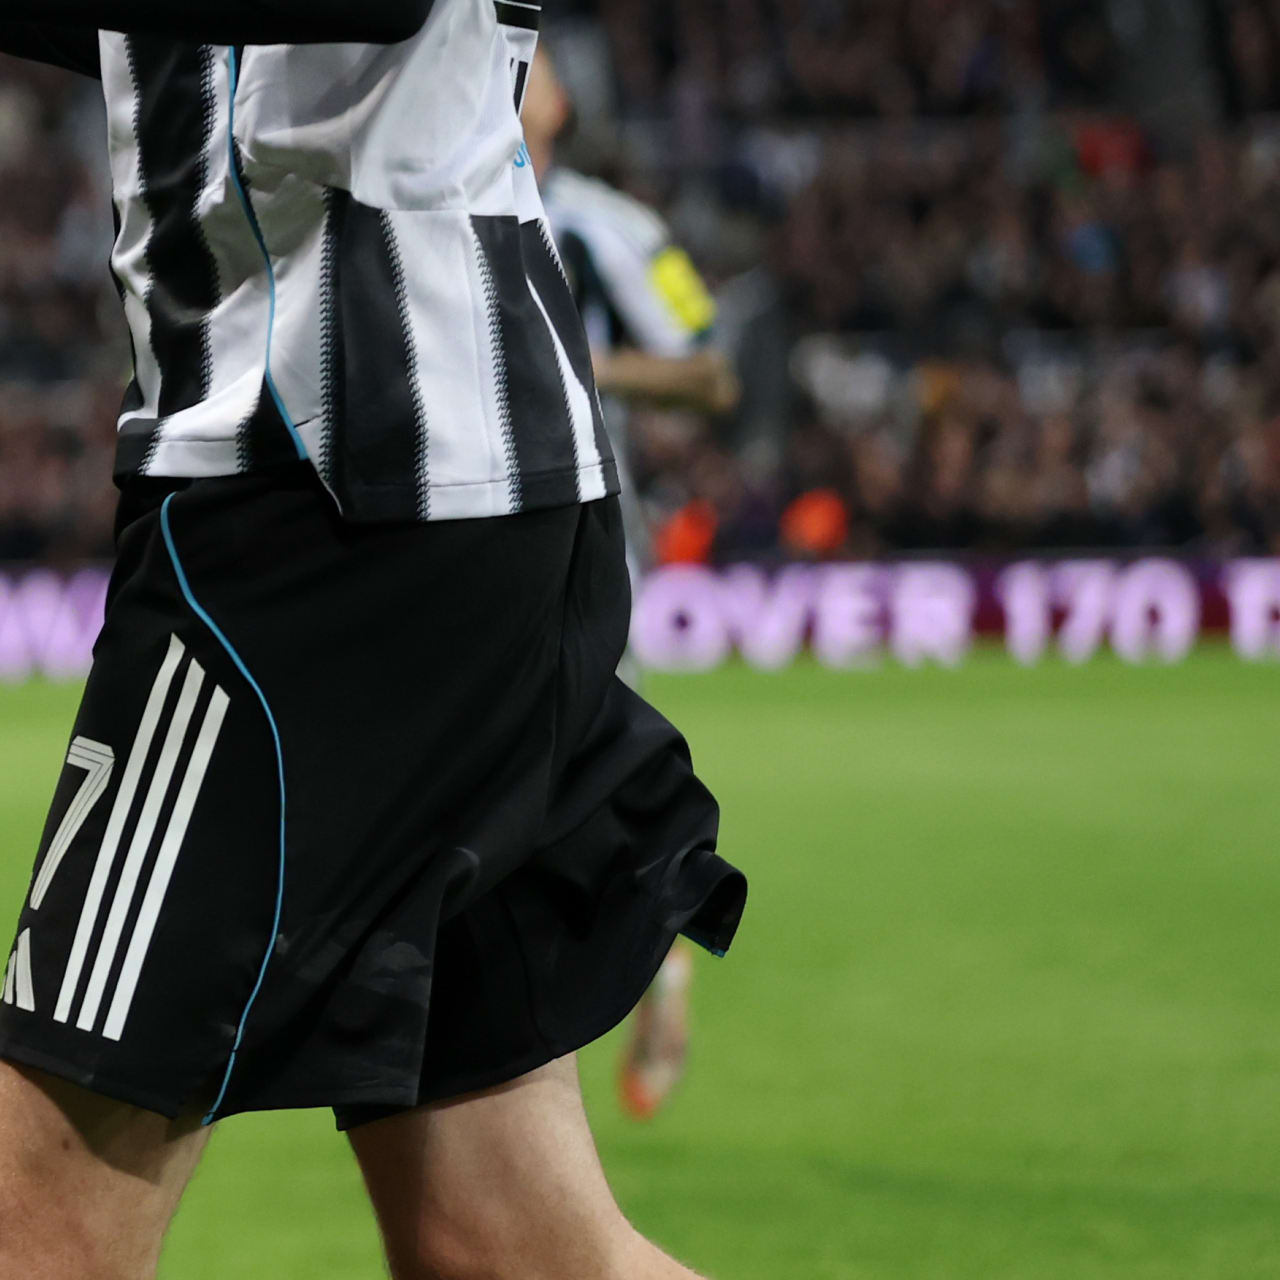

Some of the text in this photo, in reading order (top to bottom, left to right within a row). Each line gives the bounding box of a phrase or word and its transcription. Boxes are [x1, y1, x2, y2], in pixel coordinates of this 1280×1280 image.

[630, 563, 972, 672] OVER
[999, 558, 1198, 667] 170
[30, 735, 115, 910] 7
